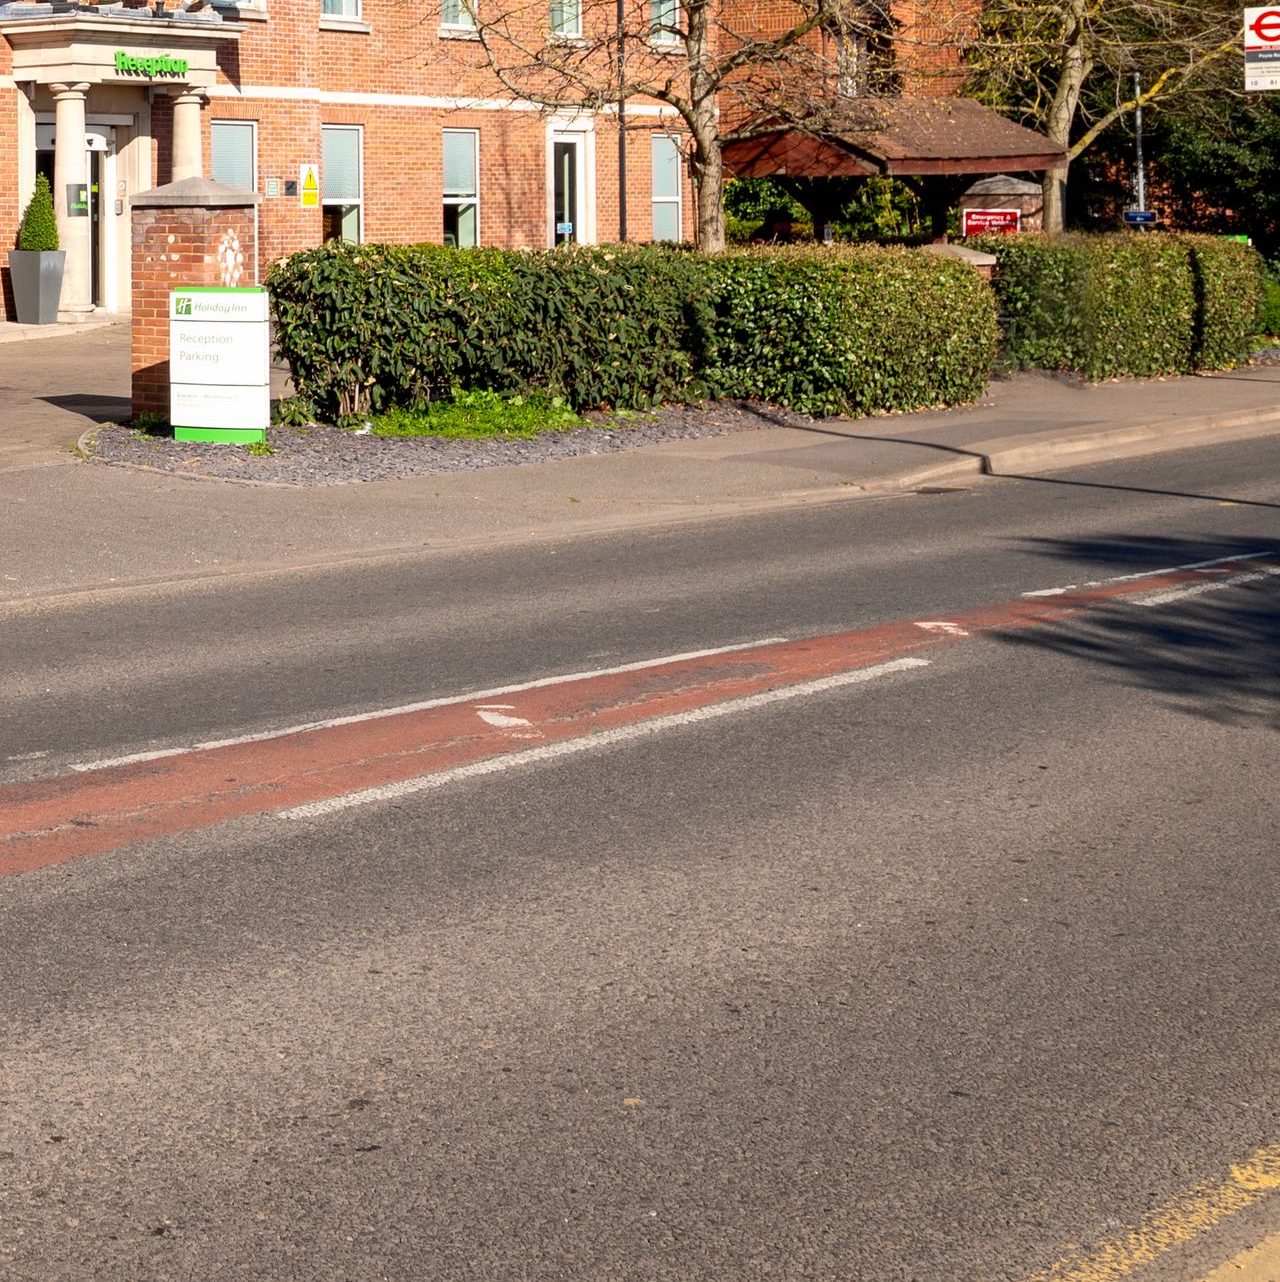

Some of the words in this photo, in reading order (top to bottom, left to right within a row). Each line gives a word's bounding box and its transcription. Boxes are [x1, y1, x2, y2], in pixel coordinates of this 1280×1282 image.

[115, 50, 189, 76] Reception
[194, 302, 231, 314] Holiday
[231, 303, 248, 312] Inn
[179, 333, 233, 345] Reception
[179, 350, 219, 364] Parking
